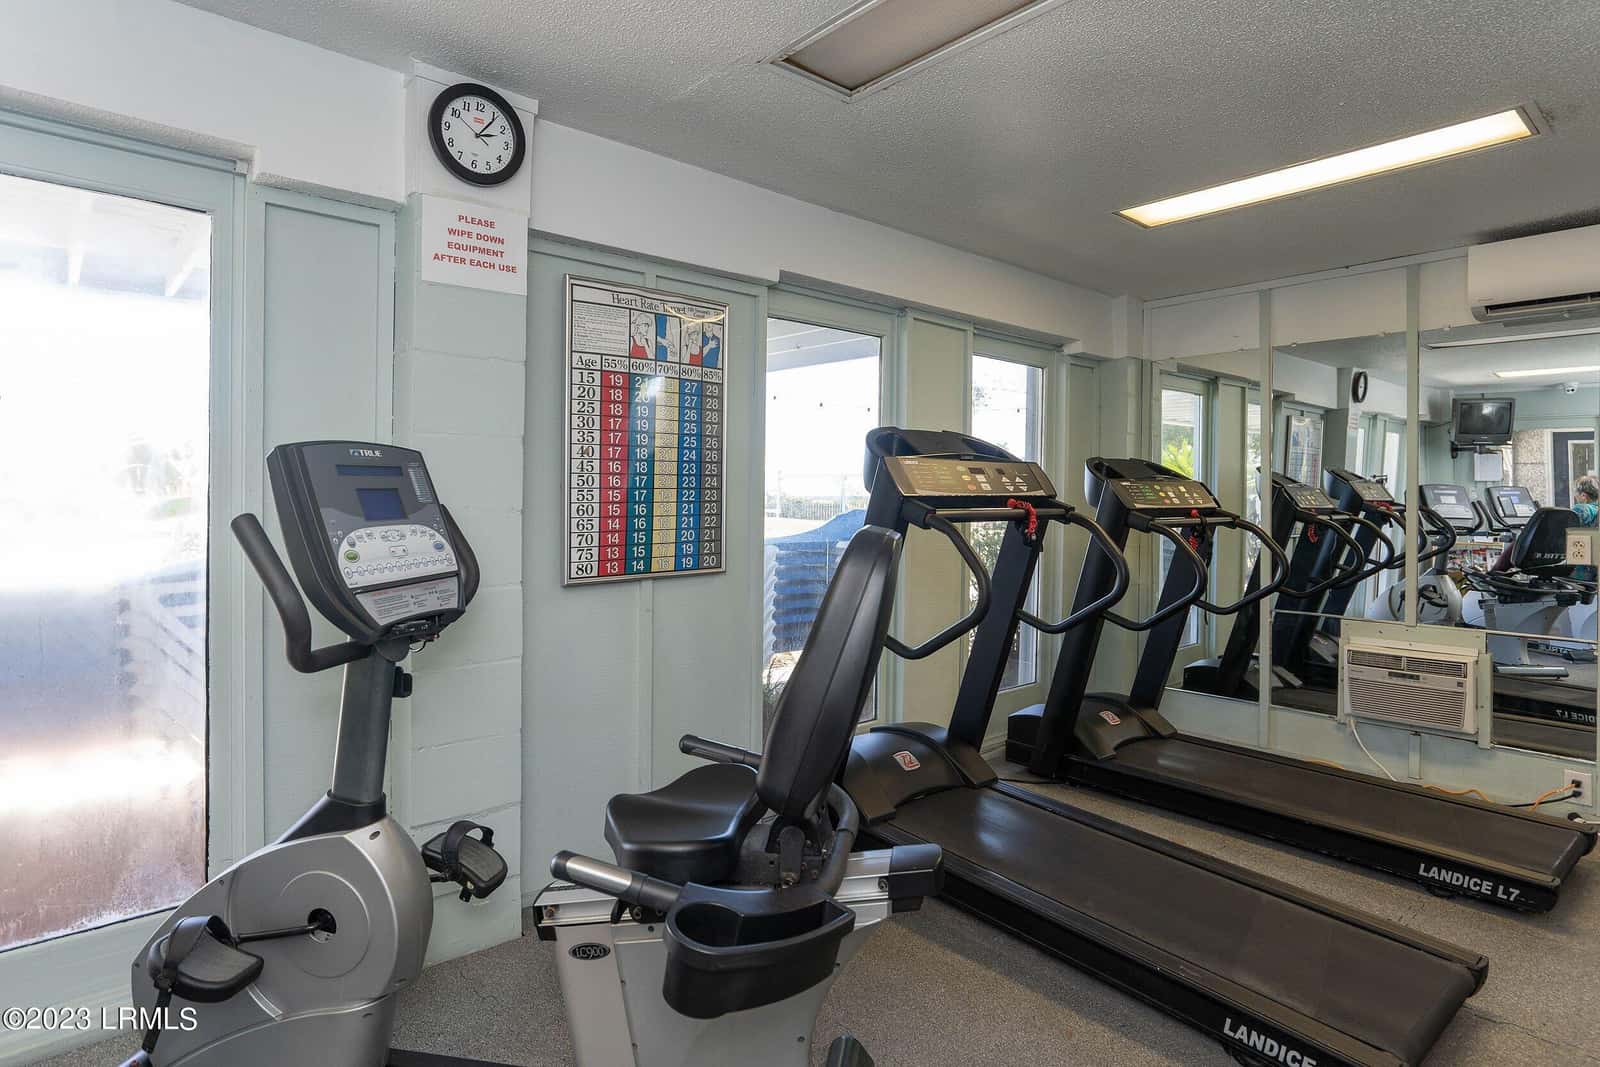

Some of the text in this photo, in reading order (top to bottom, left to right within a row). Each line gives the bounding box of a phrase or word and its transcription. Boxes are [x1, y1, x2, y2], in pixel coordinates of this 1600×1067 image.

[450, 107, 460, 118] 10
[463, 101, 470, 112] 11
[475, 102, 486, 112] 12
[444, 121, 450, 131] 9
[500, 126, 506, 134] 2
[448, 138, 454, 148] 8
[503, 141, 509, 150] 3
[457, 151, 463, 160] 7
[496, 155, 502, 164] 4
[471, 160, 478, 169] 6
[486, 161, 492, 170] 5
[458, 214, 496, 229] PLEASE
[448, 228, 504, 244] WIPE DOWN
[447, 242, 504, 258] EQUIPMENT
[432, 252, 518, 274] AFTER EACH USE
[612, 294, 638, 307] Heart
[640, 298, 660, 311] Rate
[576, 356, 722, 381] Age 55% 60% 70% 80% 85%
[578, 372, 594, 383] 15
[609, 375, 622, 386] 19
[685, 382, 696, 392] 27
[706, 386, 718, 396] 29
[578, 386, 596, 398] 20
[609, 390, 622, 400] 18
[685, 396, 696, 407] 27
[706, 400, 718, 409] 28
[577, 402, 595, 414] 25
[609, 404, 622, 415] 18
[636, 406, 648, 417] 19
[684, 410, 696, 420] 26
[706, 412, 718, 422] 28
[577, 416, 594, 428] 30
[609, 418, 622, 430] 17
[636, 420, 648, 430] 19
[684, 424, 696, 434] 25
[706, 426, 718, 435] 27
[577, 431, 594, 442] 35
[608, 433, 622, 444] 17
[636, 434, 648, 445] 19
[684, 437, 696, 447] 25
[706, 438, 718, 448] 26
[576, 446, 594, 458] 40
[608, 448, 622, 458] 17
[636, 449, 648, 459] 18
[684, 451, 696, 460] 24
[706, 451, 717, 460] 26
[576, 460, 594, 472] 45
[608, 462, 621, 472] 16
[635, 462, 647, 472] 18
[682, 464, 696, 474] 23
[705, 464, 717, 474] 25
[576, 475, 594, 486] 50
[608, 476, 620, 486] 16
[635, 477, 647, 487] 17
[682, 478, 696, 487] 23
[705, 478, 717, 487] 24
[576, 490, 594, 502] 55
[608, 490, 620, 501] 15
[634, 490, 646, 501] 17
[682, 490, 695, 500] 22
[705, 490, 717, 500] 23
[576, 504, 594, 516] 60
[608, 505, 620, 516] 15
[634, 505, 646, 515] 16
[682, 504, 694, 514] 21
[704, 504, 716, 513] 23
[576, 519, 594, 530] 65
[608, 520, 620, 530] 14
[634, 519, 646, 529] 16
[682, 517, 694, 527] 21
[704, 517, 716, 526] 22
[576, 534, 594, 546] 70
[607, 534, 619, 544] 14
[634, 533, 646, 543] 15
[682, 530, 694, 540] 20
[704, 530, 715, 540] 21
[576, 549, 593, 560] 75
[606, 548, 619, 558] 13
[633, 547, 645, 557] 15
[682, 544, 692, 554] 19
[704, 543, 715, 552] 21
[576, 564, 593, 575] 80
[606, 562, 618, 573] 13
[632, 561, 644, 571] 14
[682, 558, 692, 568] 19
[704, 556, 716, 566] 20
[1418, 864, 1520, 902] LANDICE L7
[1224, 1018, 1317, 1067] LANDICE
